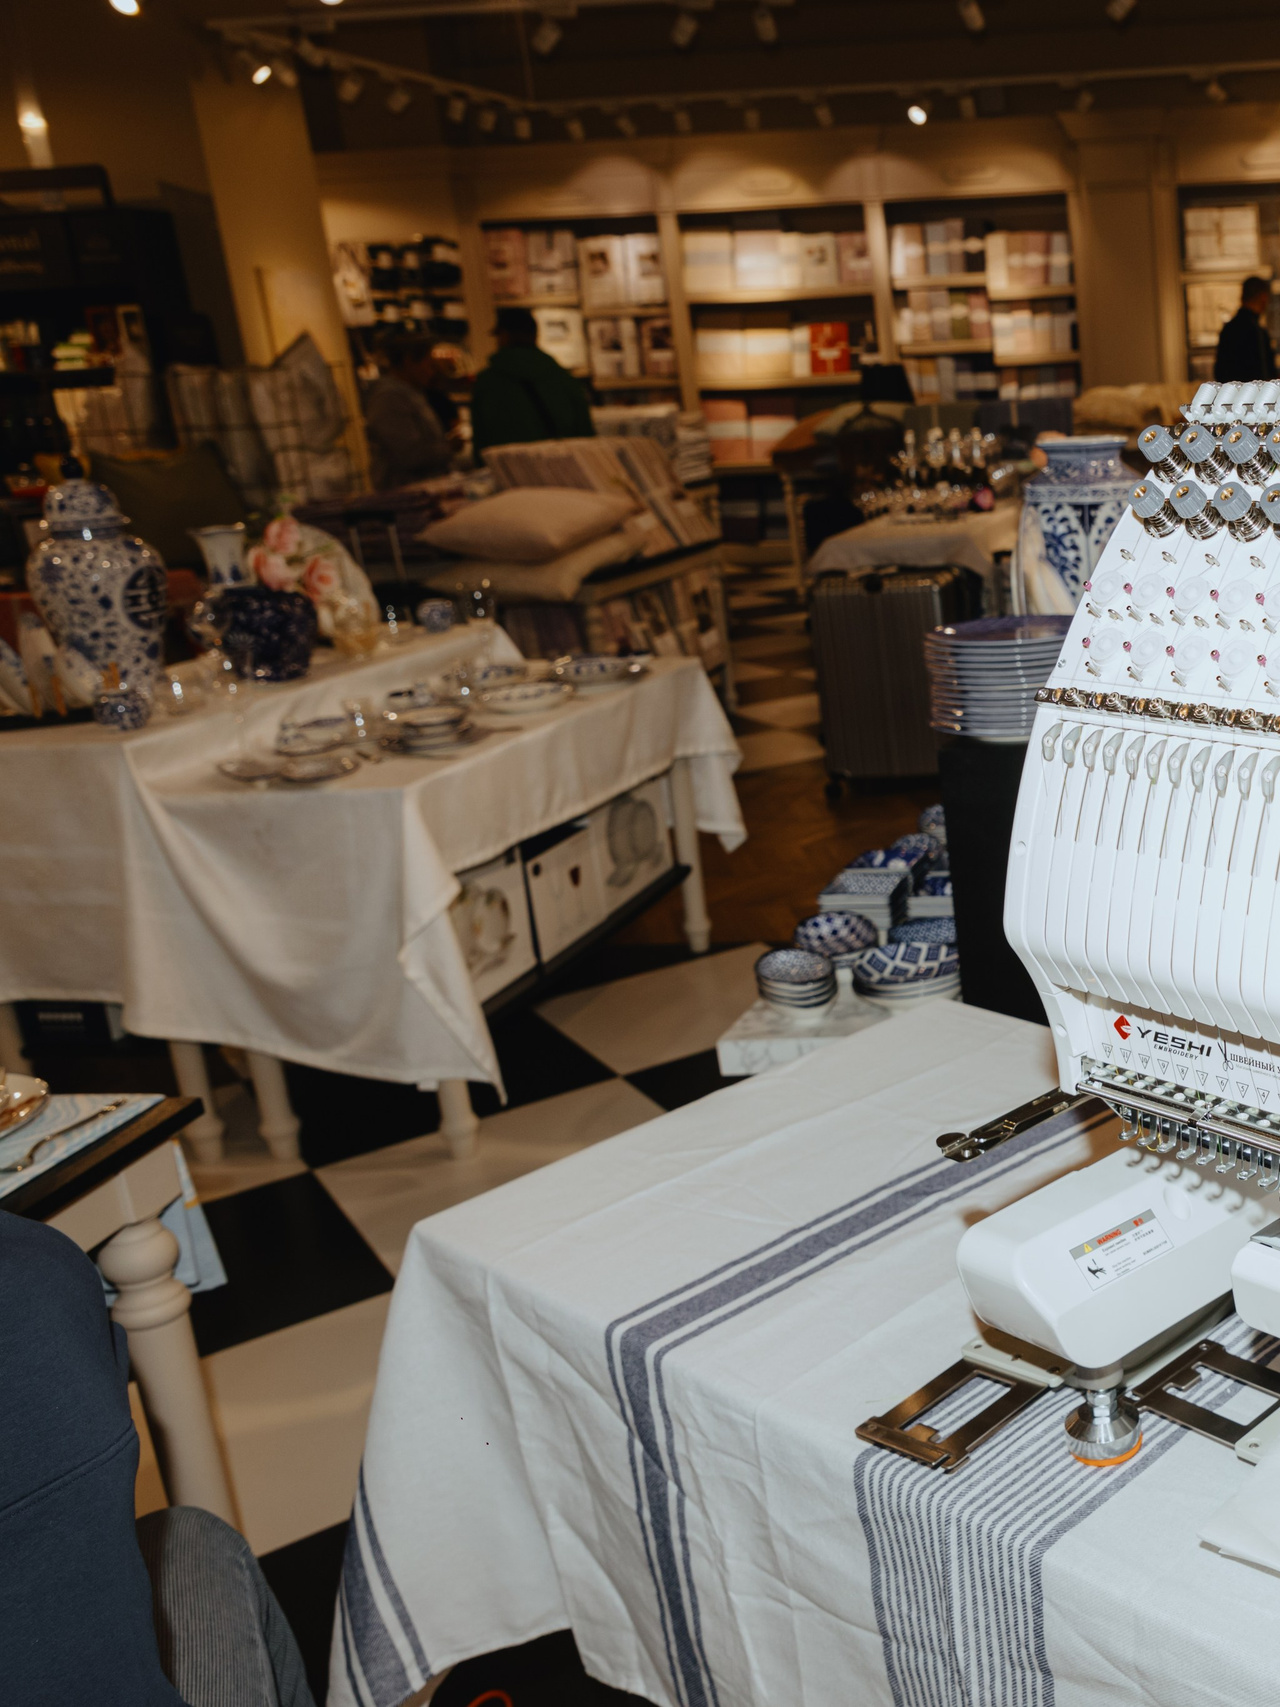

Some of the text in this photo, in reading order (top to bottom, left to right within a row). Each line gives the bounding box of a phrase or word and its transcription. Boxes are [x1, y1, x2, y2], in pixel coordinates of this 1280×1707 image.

[1136, 1026, 1212, 1057] YESHI
[1153, 1044, 1199, 1060] EMBROIDERY
[1230, 1053, 1275, 1073] ШВЕЙНЫЙ
[1096, 1228, 1122, 1245] WARNING
